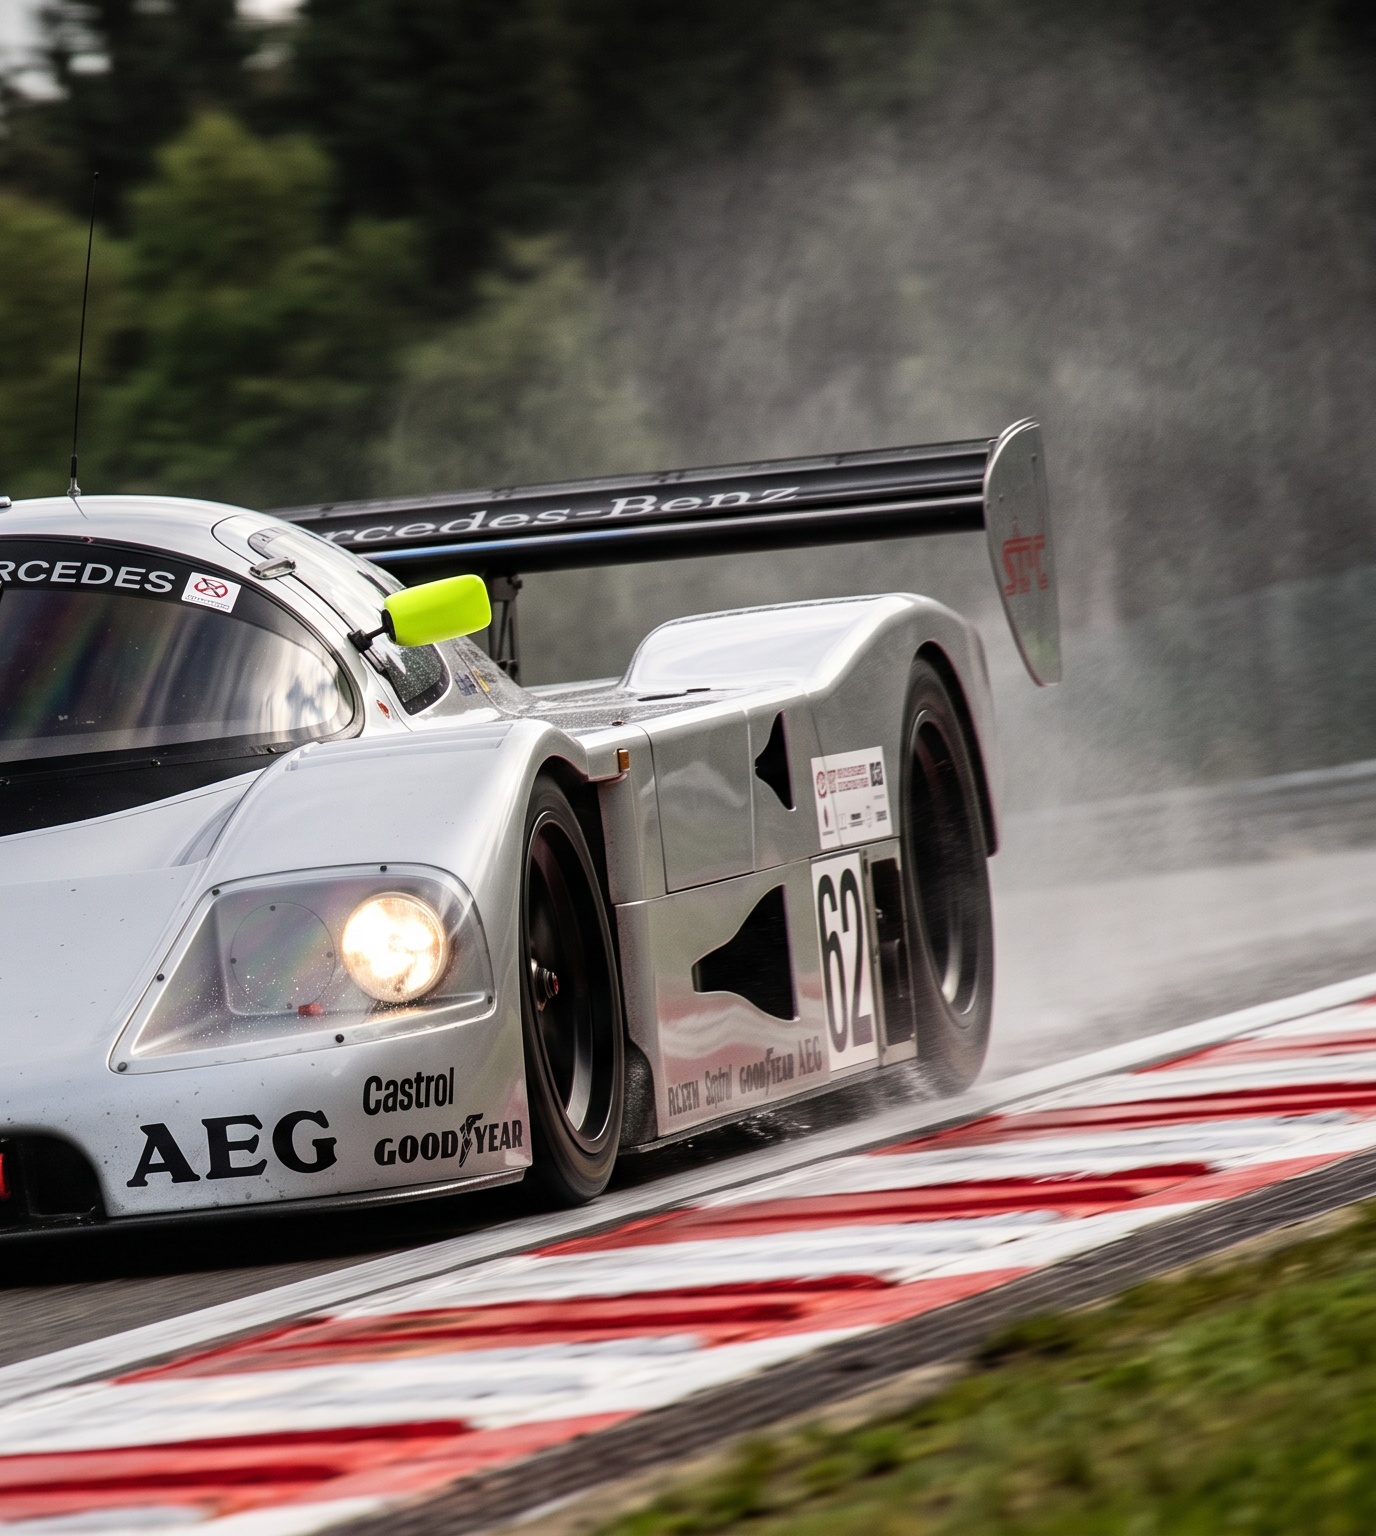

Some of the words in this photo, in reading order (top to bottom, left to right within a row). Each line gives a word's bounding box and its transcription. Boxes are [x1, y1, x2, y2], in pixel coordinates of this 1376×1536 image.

[324, 487, 801, 542] rcedes-Benz
[818, 868, 874, 1053] 62
[798, 1036, 823, 1077] AEG
[362, 1067, 455, 1116] Castrol
[126, 1110, 338, 1188] AEG
